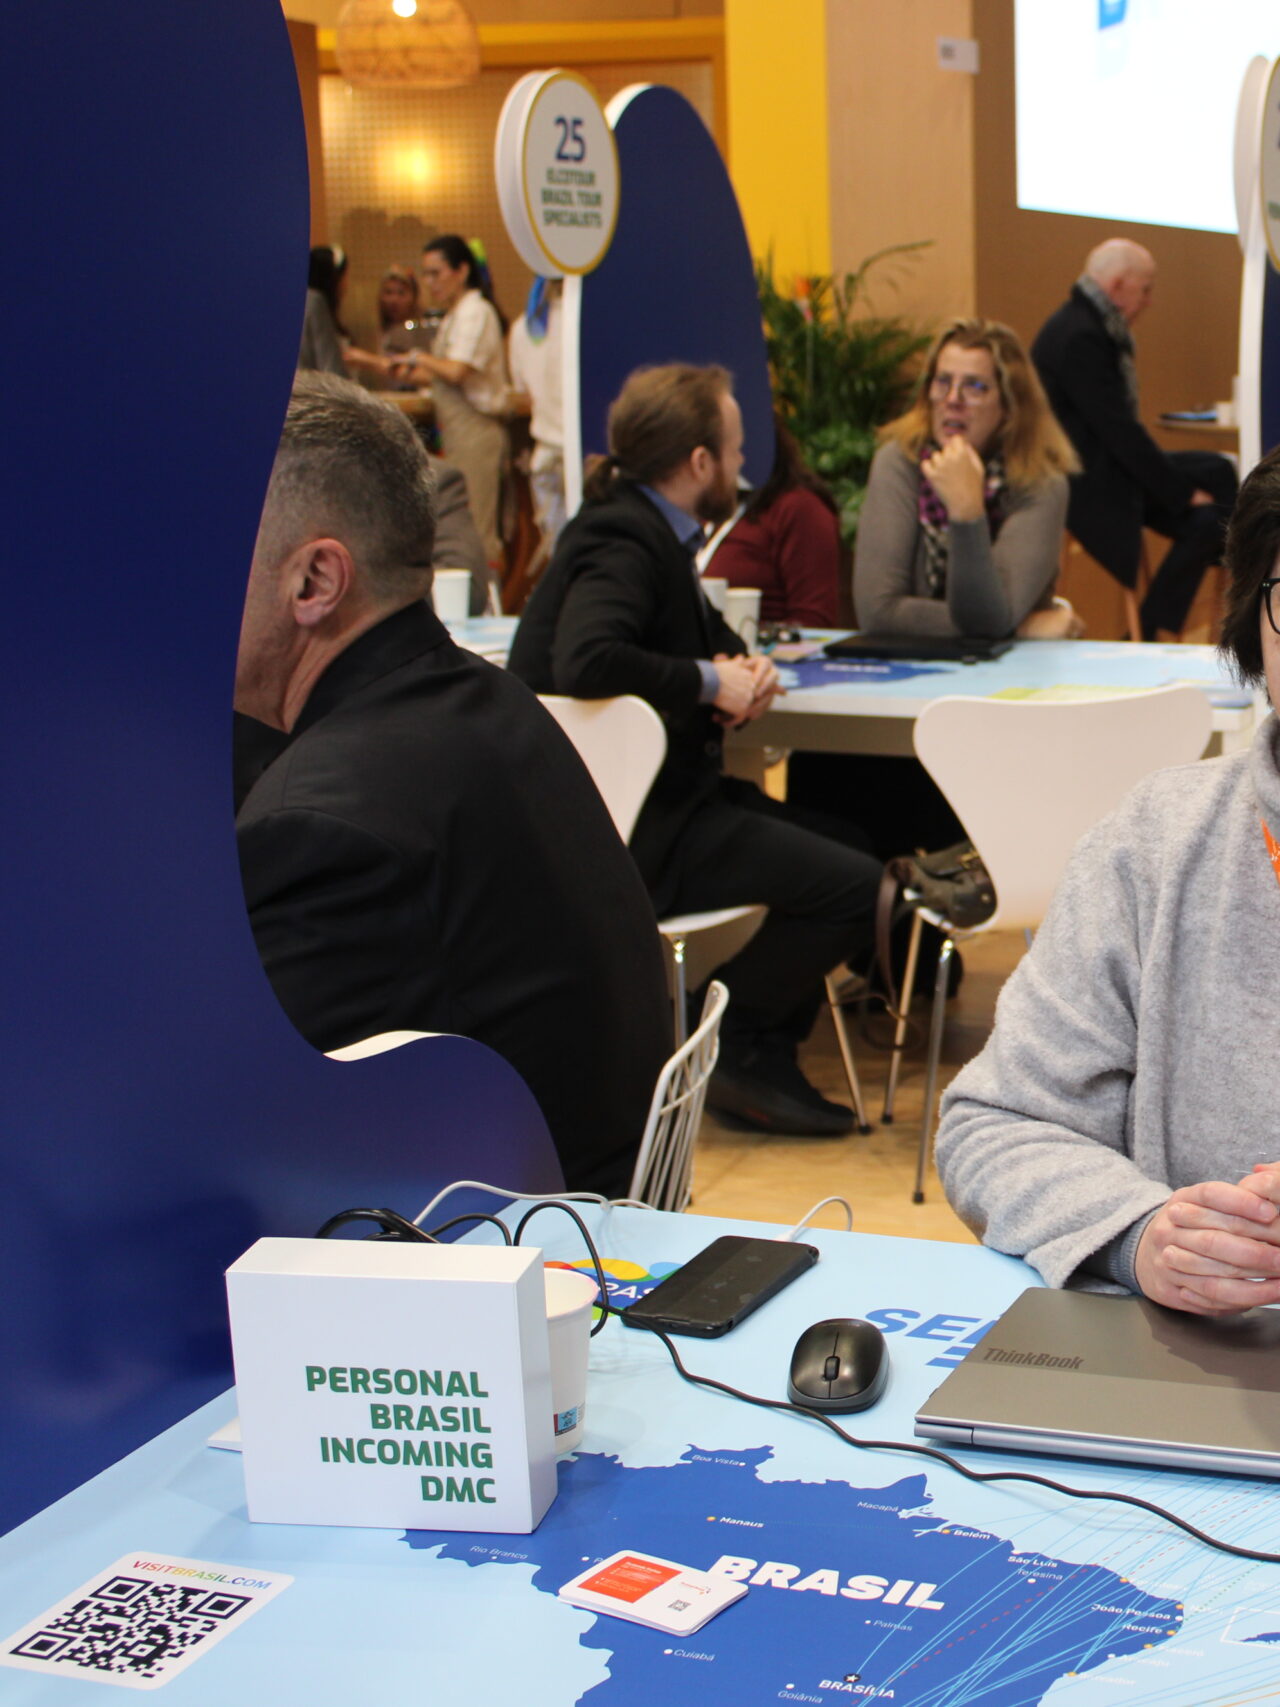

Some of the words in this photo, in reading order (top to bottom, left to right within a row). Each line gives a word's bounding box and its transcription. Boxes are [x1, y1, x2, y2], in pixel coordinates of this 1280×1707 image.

[555, 116, 586, 163] 25
[576, 190, 602, 208] TOUR
[983, 1347, 1084, 1370] ThinkBook
[305, 1365, 489, 1398] PERSONAL
[370, 1403, 492, 1434] BRASIL
[320, 1436, 493, 1469] INCOMING
[421, 1475, 497, 1504] DMC
[719, 1516, 764, 1528] Manaus
[953, 1529, 990, 1540] Belém
[133, 1560, 273, 1590] VISITBRASIL.COM
[706, 1554, 946, 1610] BRASIL
[674, 1649, 715, 1662] Cuiabá
[777, 1690, 824, 1704] Goiânia
[818, 1679, 896, 1699] BRASÍLIA
